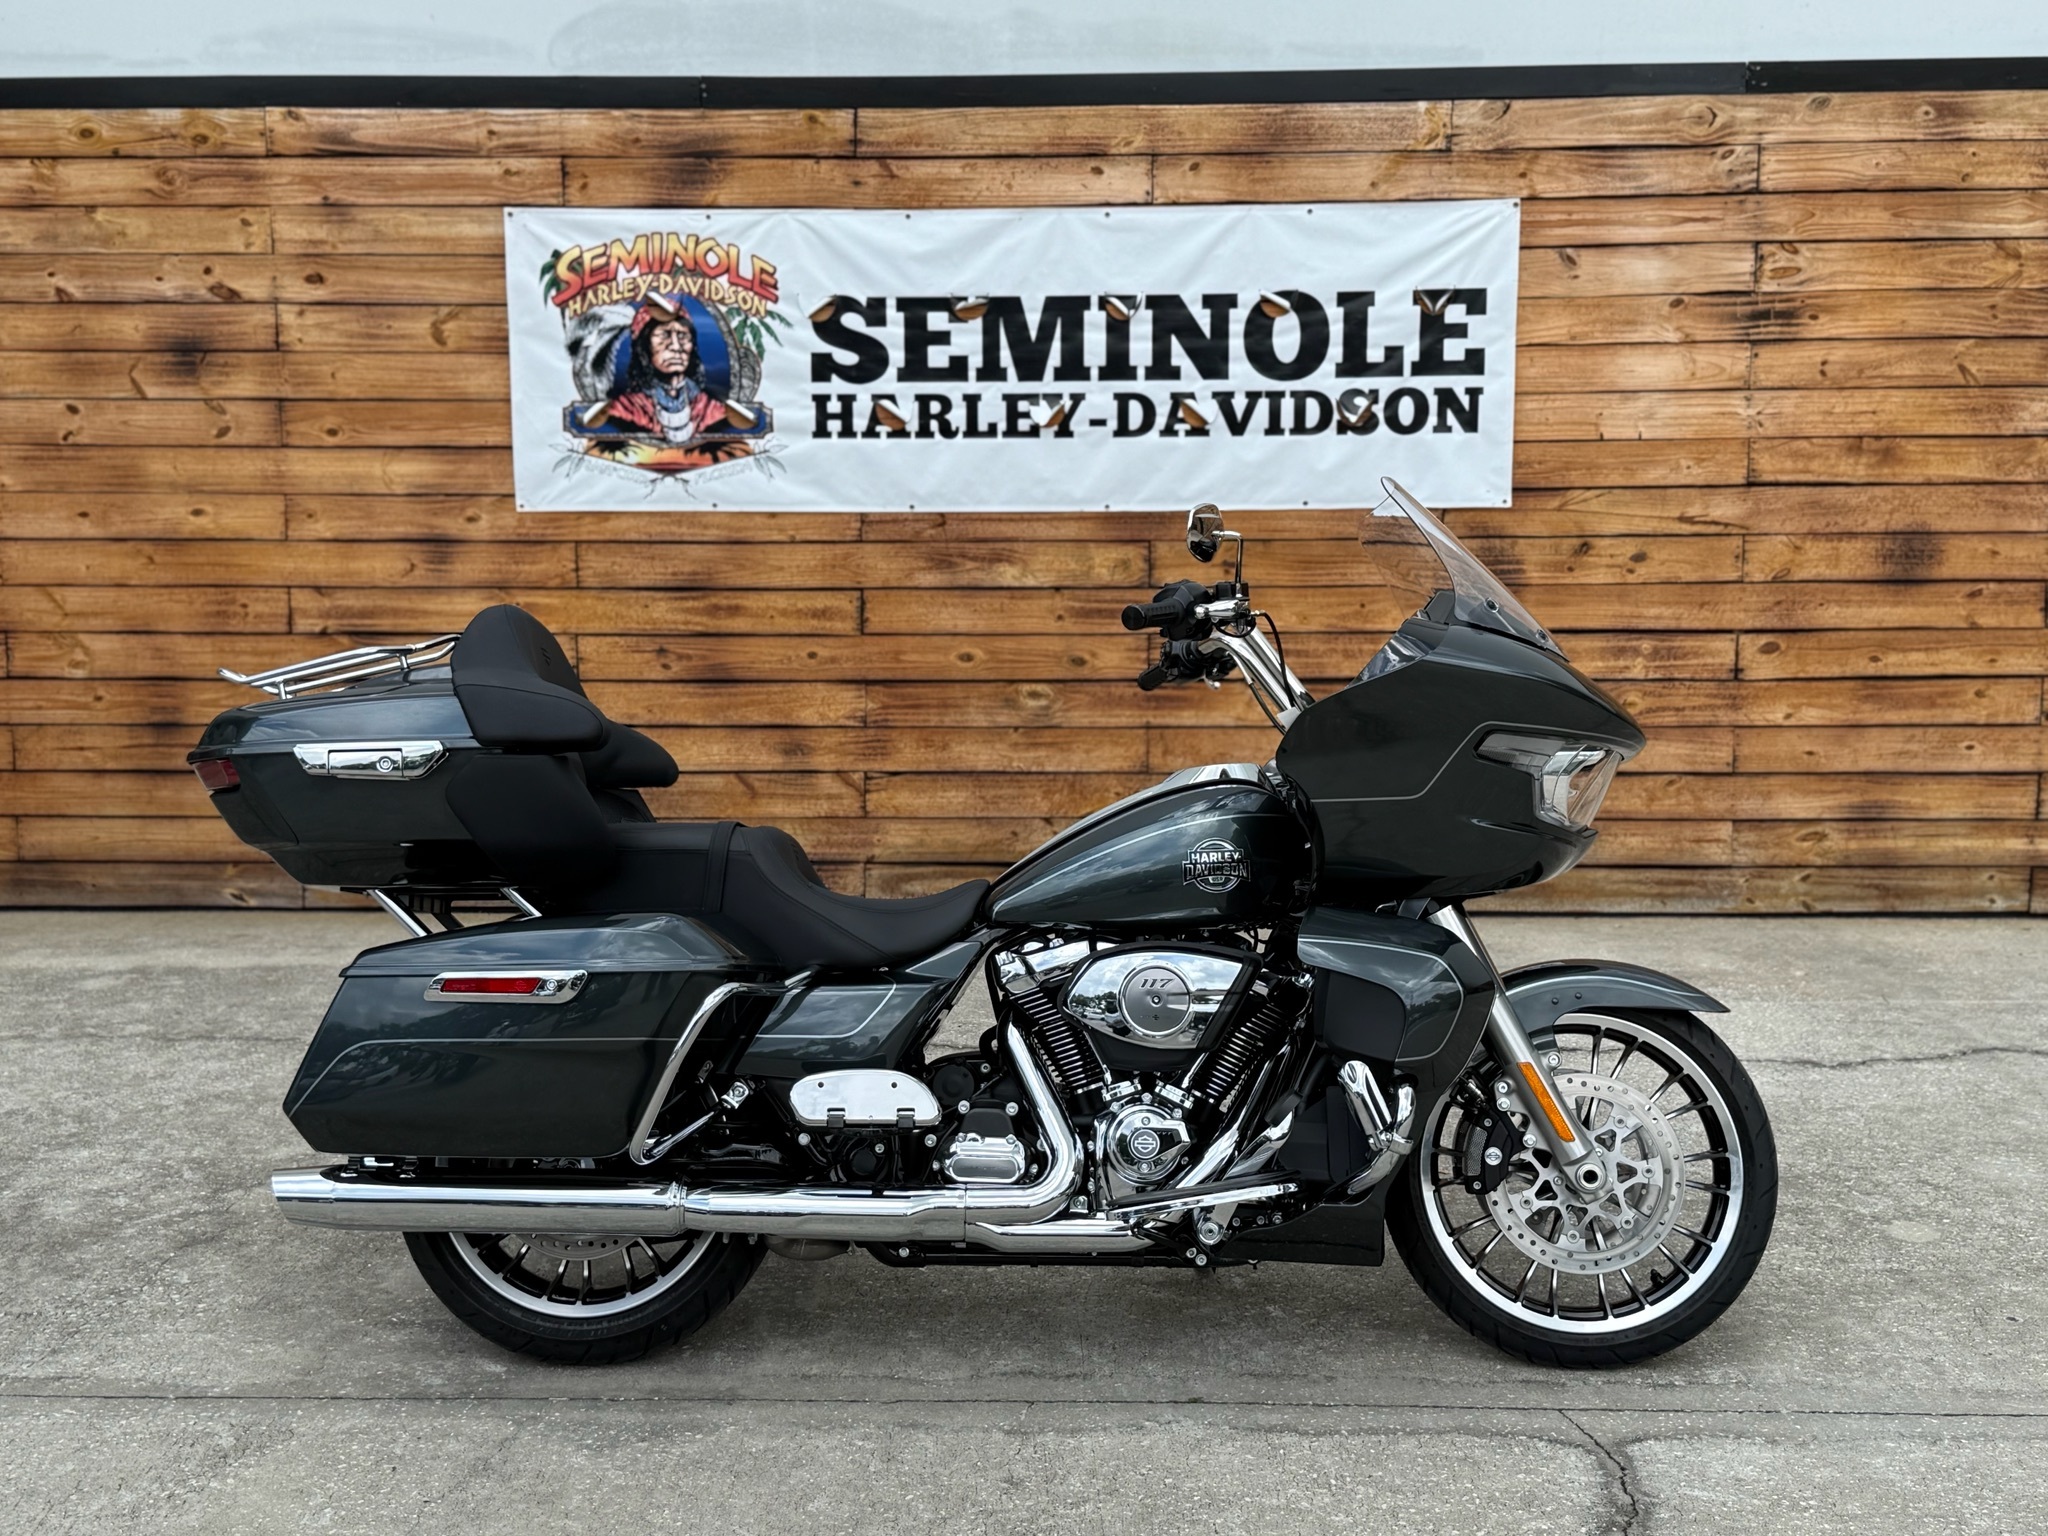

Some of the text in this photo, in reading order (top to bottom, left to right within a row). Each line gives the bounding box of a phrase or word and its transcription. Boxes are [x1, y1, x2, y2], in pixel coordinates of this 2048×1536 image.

[552, 232, 779, 307] SEMINOLE
[568, 273, 768, 317] HARLEY-DAVIDSON
[811, 288, 1487, 384] SEMINOLE
[811, 387, 1484, 440] HARLEY-DAVIDSON
[1185, 863, 1247, 880] DAVIDSON
[1139, 978, 1174, 989] 117
